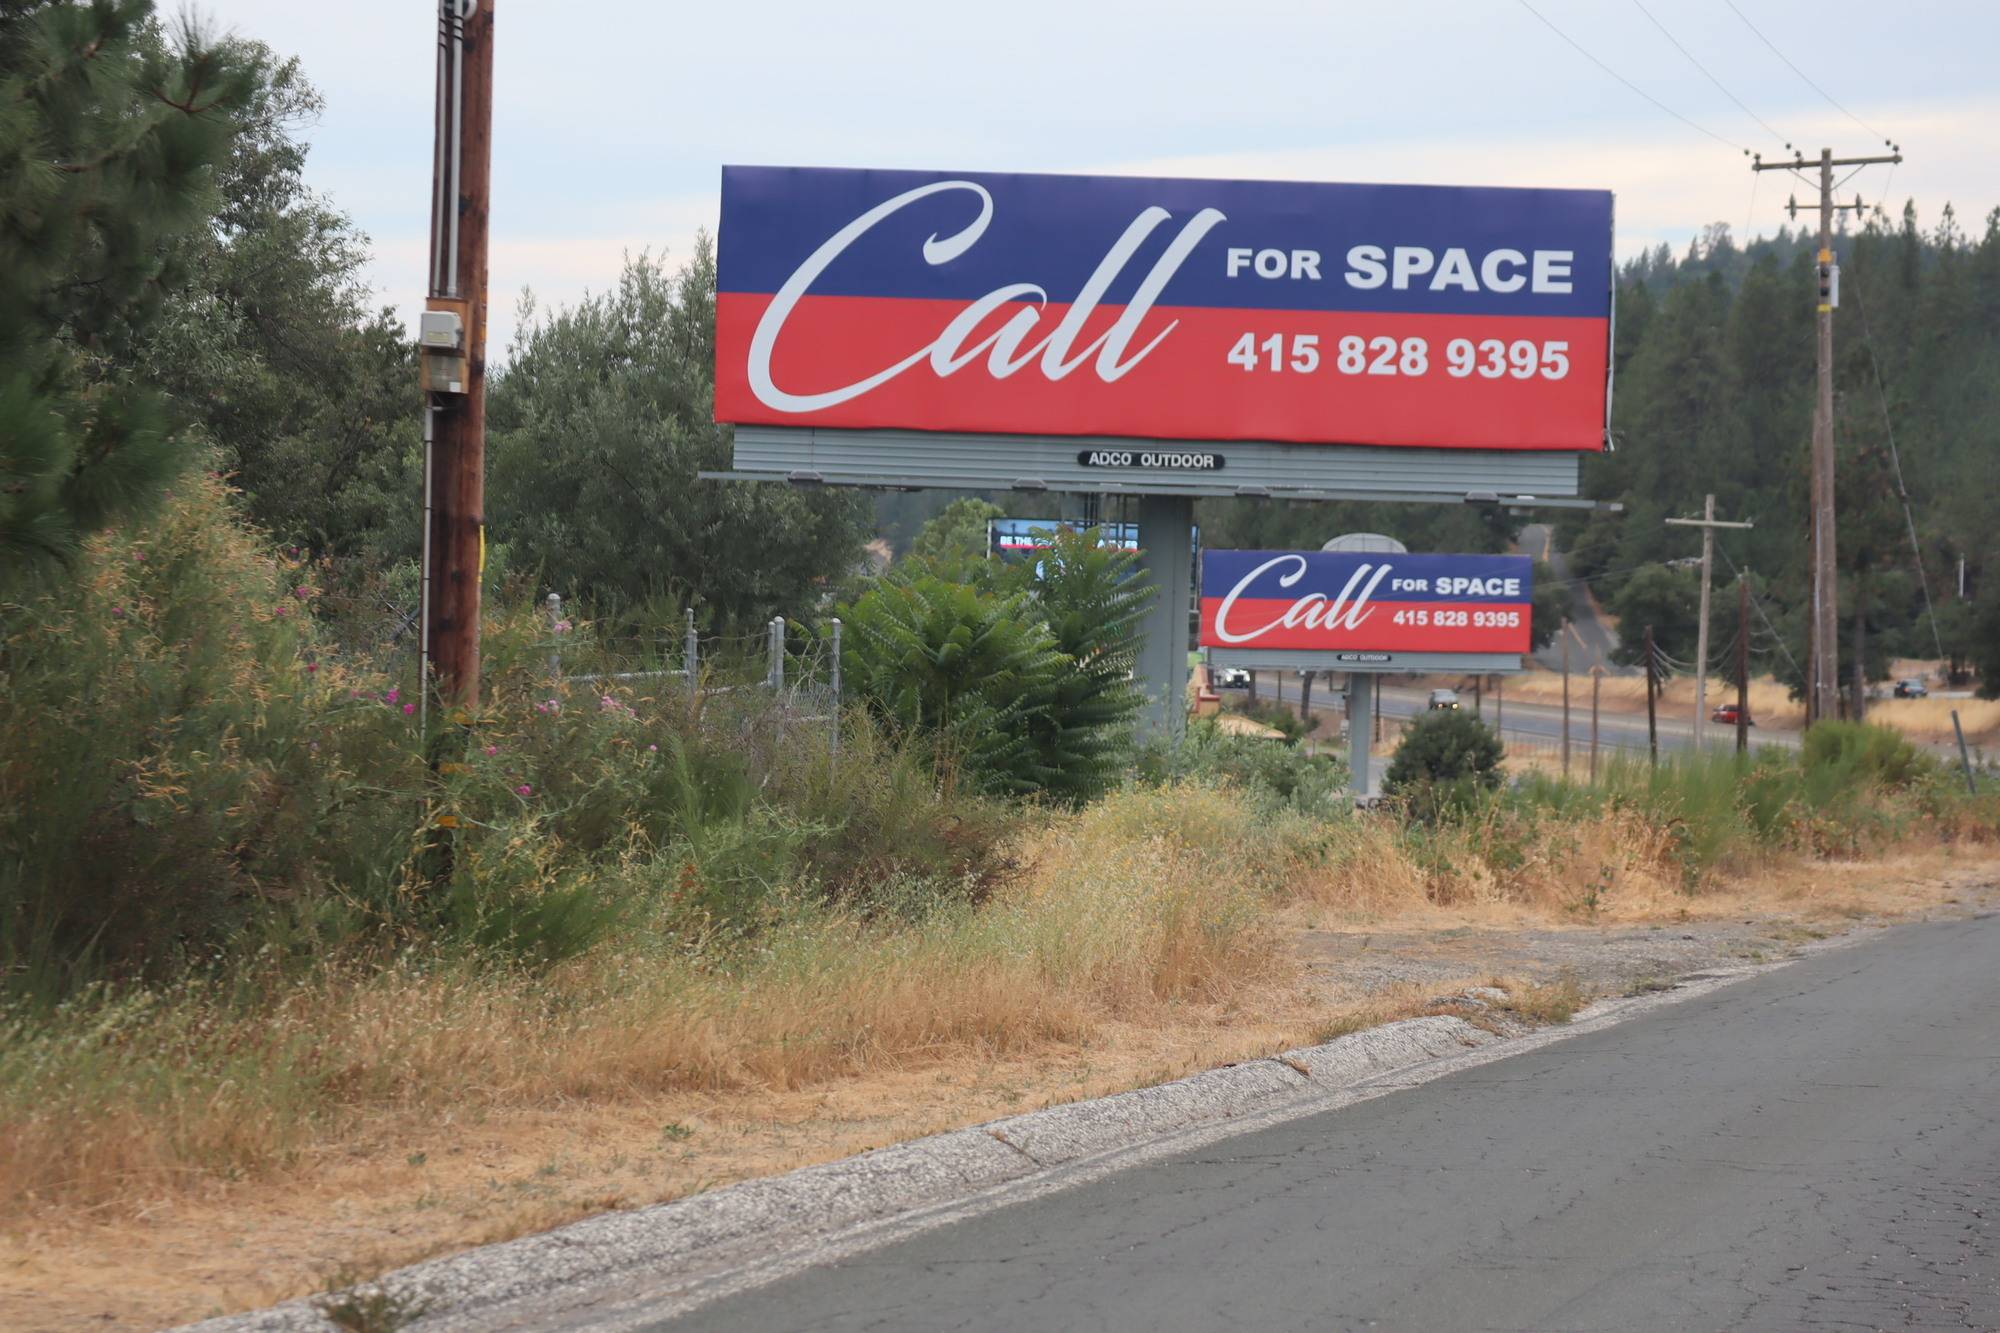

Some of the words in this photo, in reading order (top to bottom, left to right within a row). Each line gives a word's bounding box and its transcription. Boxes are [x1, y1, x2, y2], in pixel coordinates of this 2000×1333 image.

[1226, 248, 1322, 280] FOR
[1345, 245, 1574, 294] SPACE
[747, 180, 1228, 413] Call
[1227, 332, 1320, 374] 415
[1337, 335, 1429, 377] 828
[1446, 338, 1570, 380] 9395
[1089, 452, 1132, 466] ADCO
[1140, 453, 1214, 468] OUTDOOR
[1214, 554, 1393, 643] Call
[1392, 579, 1428, 592] FOR
[1435, 577, 1521, 596] SPACE
[1393, 610, 1428, 627] 415
[1434, 610, 1468, 627] 828
[1473, 611, 1520, 628] 9395
